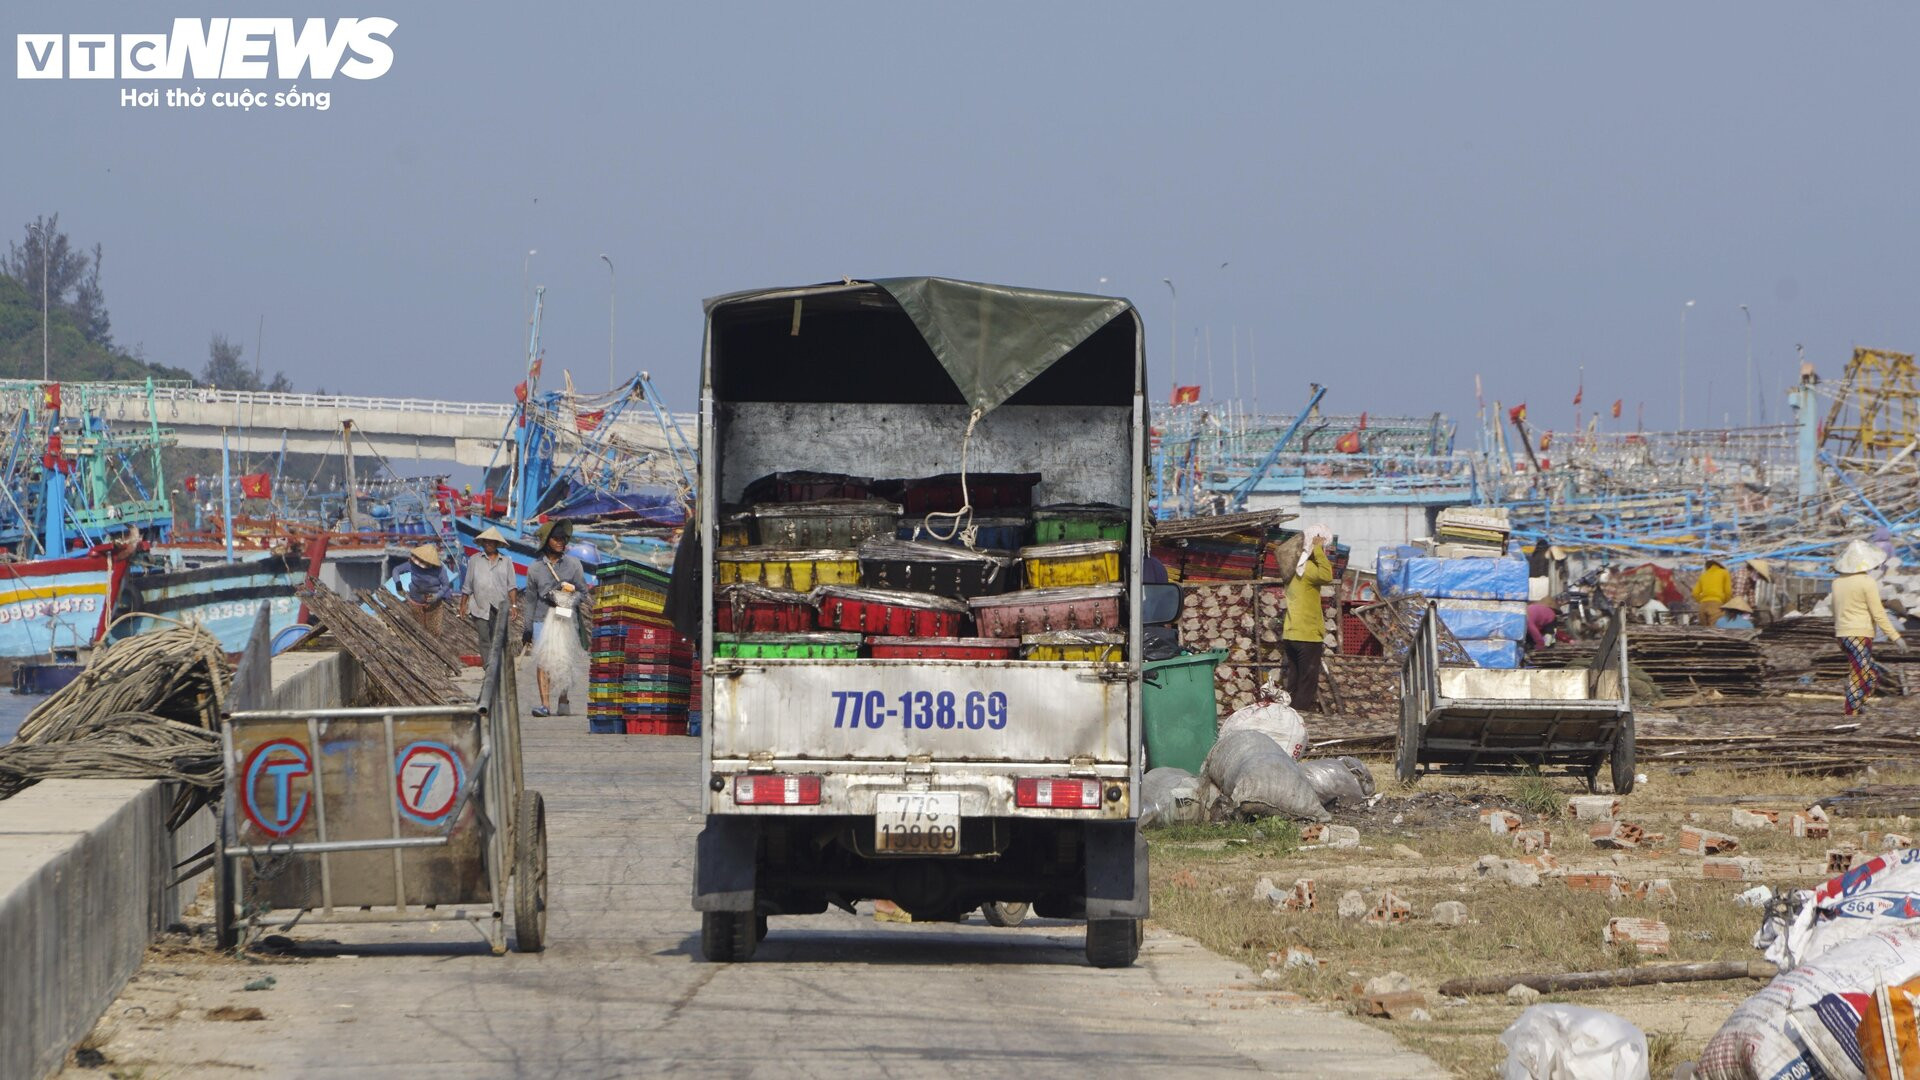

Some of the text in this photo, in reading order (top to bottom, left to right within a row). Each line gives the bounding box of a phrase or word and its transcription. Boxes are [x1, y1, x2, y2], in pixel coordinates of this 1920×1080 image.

[831, 690, 1008, 730] 77C-138.69
[409, 761, 441, 808] 7
[896, 796, 940, 822] 77C
[881, 823, 957, 849] 138.69
[1846, 901, 1876, 915] S64
